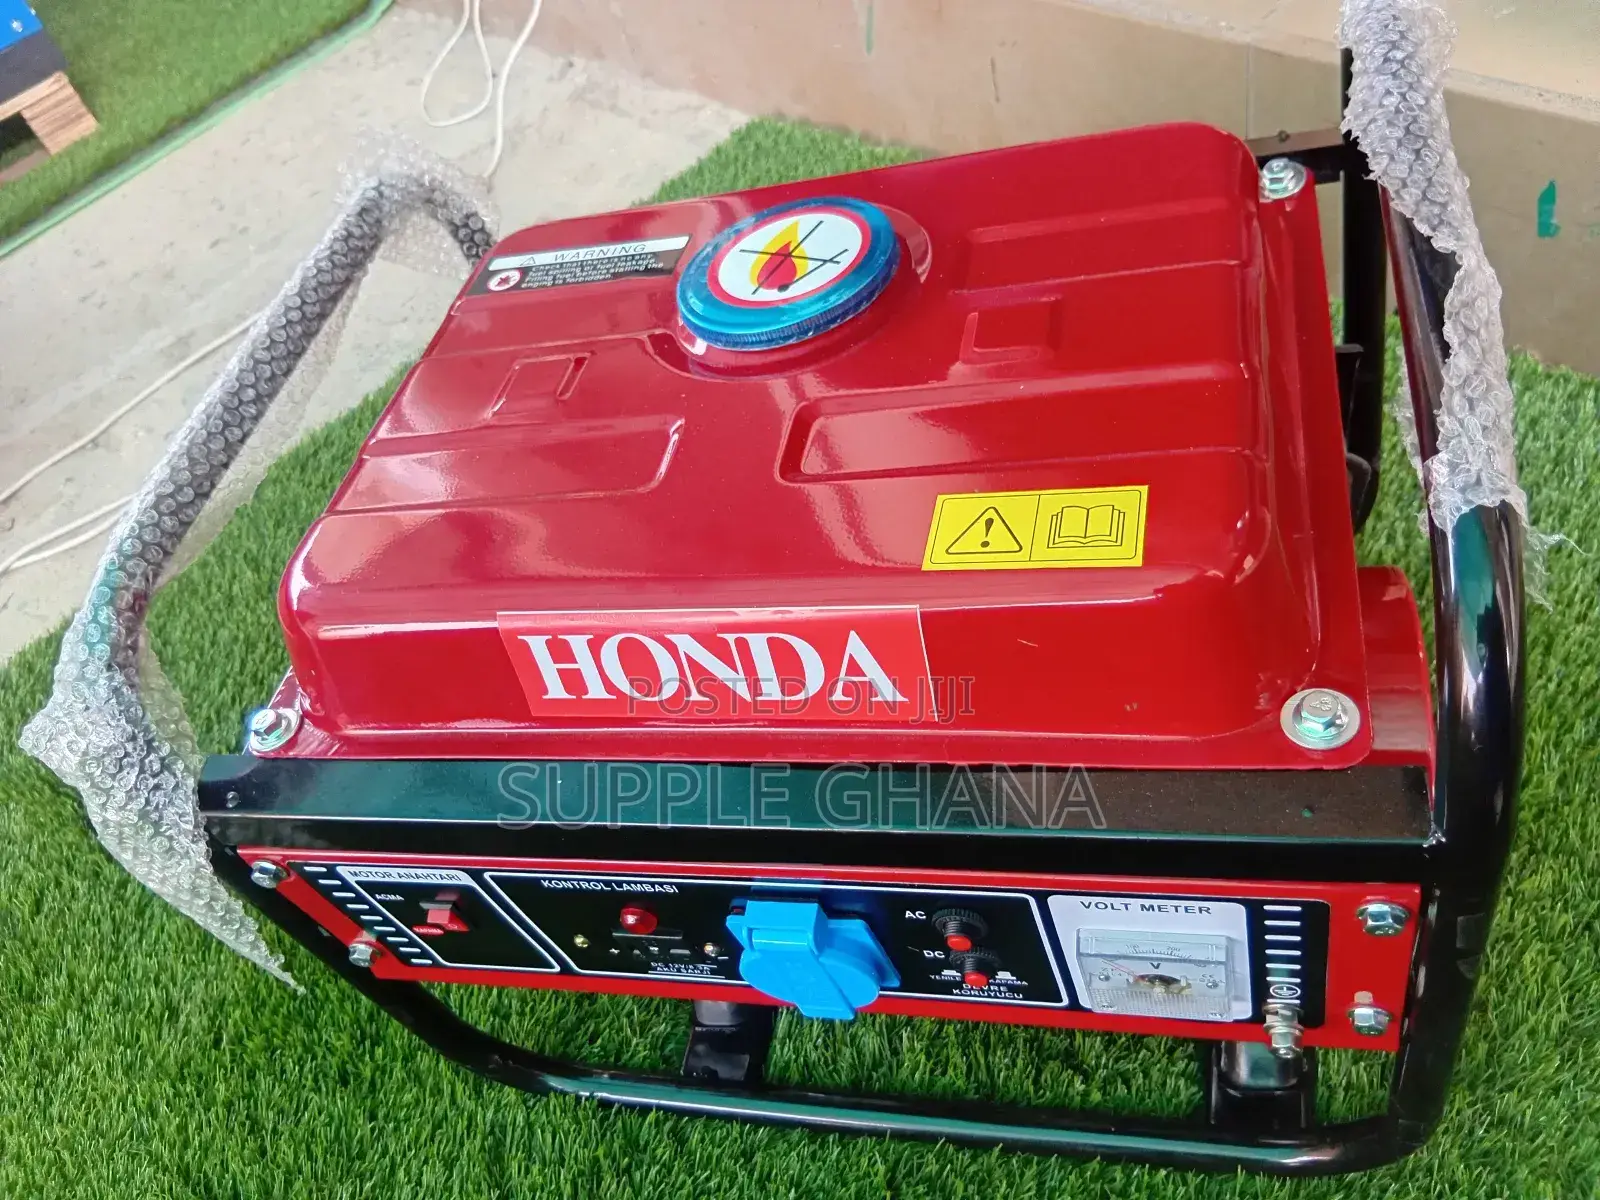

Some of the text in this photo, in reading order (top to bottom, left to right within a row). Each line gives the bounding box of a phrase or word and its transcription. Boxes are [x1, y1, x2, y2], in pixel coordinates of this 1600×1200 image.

[554, 244, 646, 261] WARNING
[517, 630, 909, 702] HONDA
[347, 870, 463, 882] MOTOR ANAHTARI
[540, 879, 679, 893] KONTROL LAMBASI
[1080, 900, 1212, 915] VOLT METER
[905, 910, 927, 919] AC
[923, 950, 945, 958] DC
[1149, 962, 1161, 970] V
[952, 988, 1023, 999] KORUYUCU
